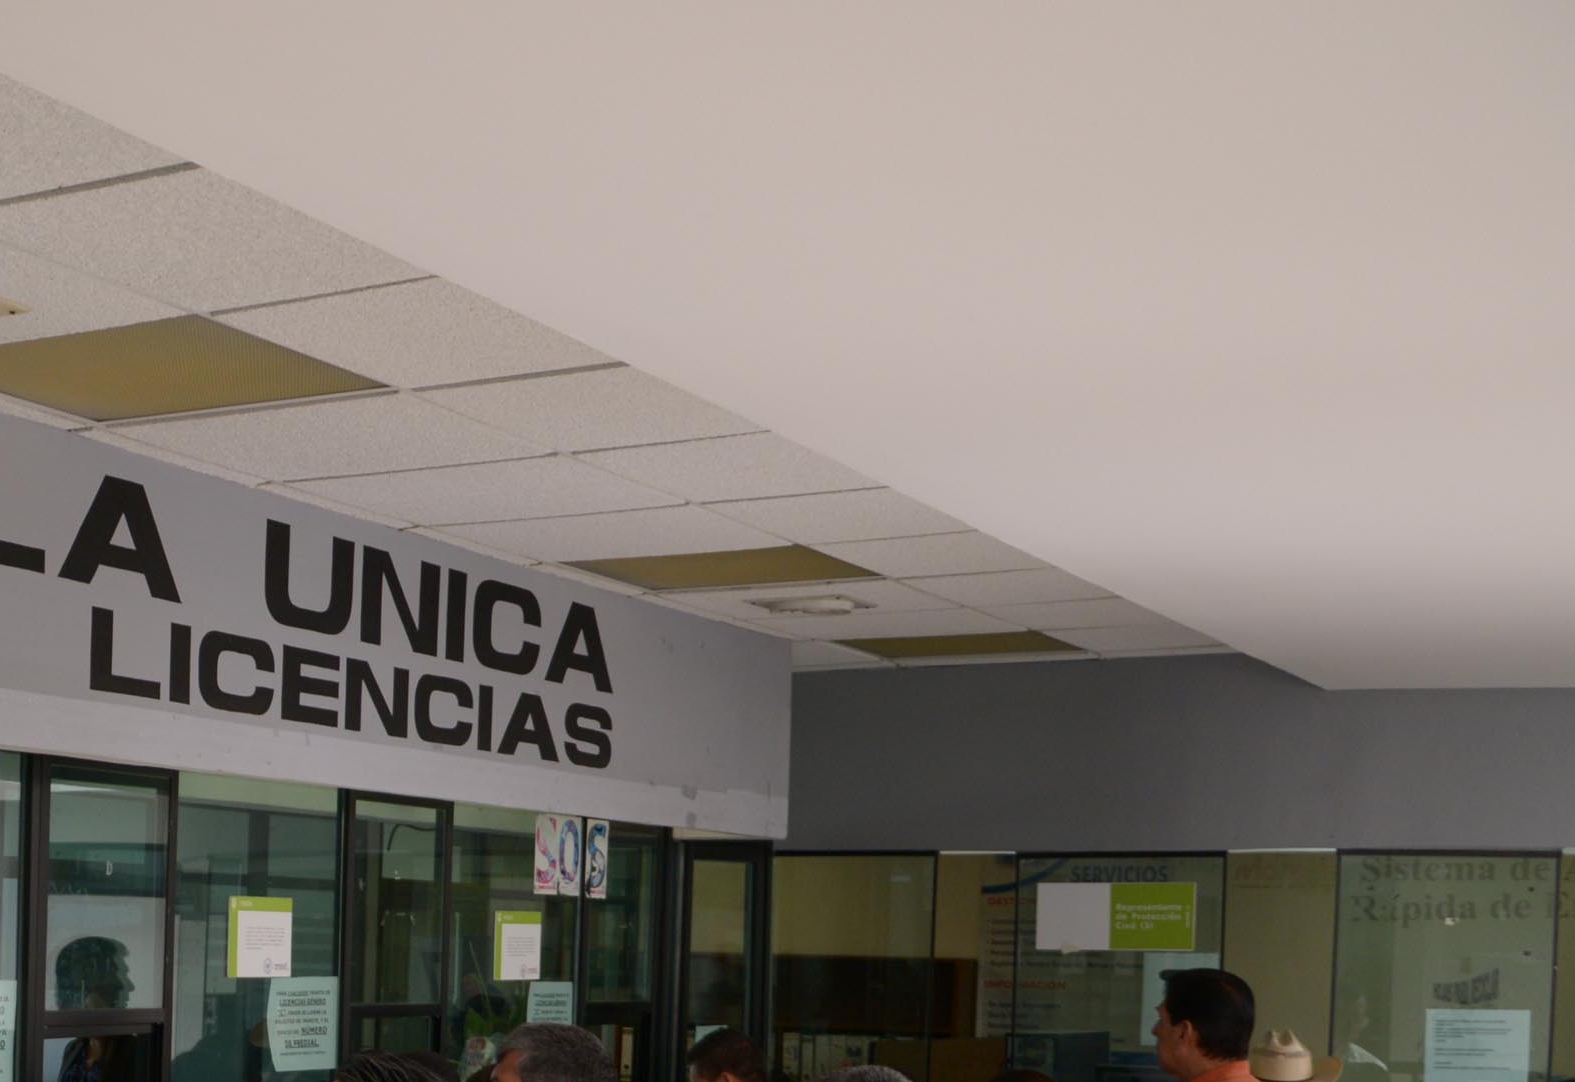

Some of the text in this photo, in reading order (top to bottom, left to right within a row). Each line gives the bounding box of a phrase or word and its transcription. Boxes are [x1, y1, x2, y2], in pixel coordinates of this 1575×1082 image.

[265, 518, 613, 693] UNICA
[90, 605, 613, 770] LICENCIAS
[1070, 864, 1169, 882] SERVICIOS
[1509, 859, 1550, 881] de
[1489, 892, 1533, 920] de
